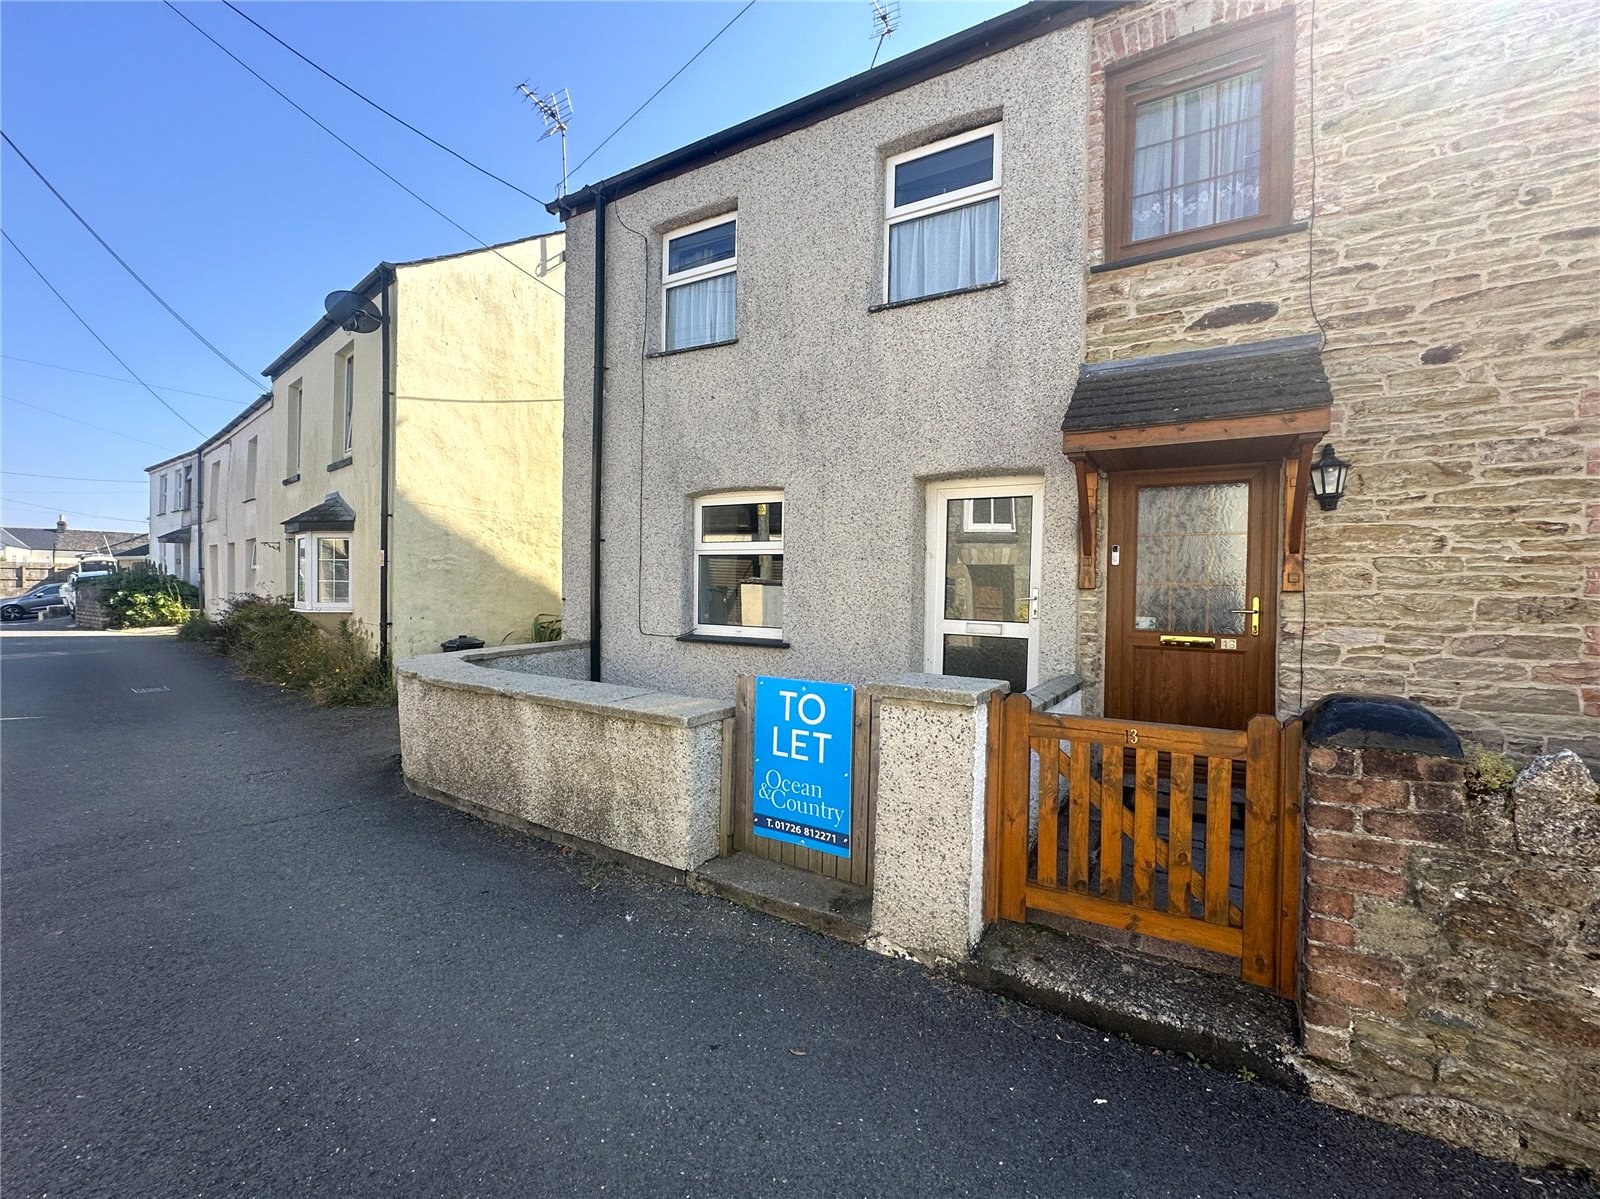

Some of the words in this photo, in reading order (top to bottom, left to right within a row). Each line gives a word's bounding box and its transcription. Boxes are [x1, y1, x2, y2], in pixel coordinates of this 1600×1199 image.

[779, 690, 826, 725] TO
[772, 726, 832, 763] LET
[1124, 728, 1138, 744] 13
[765, 769, 822, 798] Ocean
[774, 819, 801, 835] 01726
[803, 826, 836, 843] 812271
